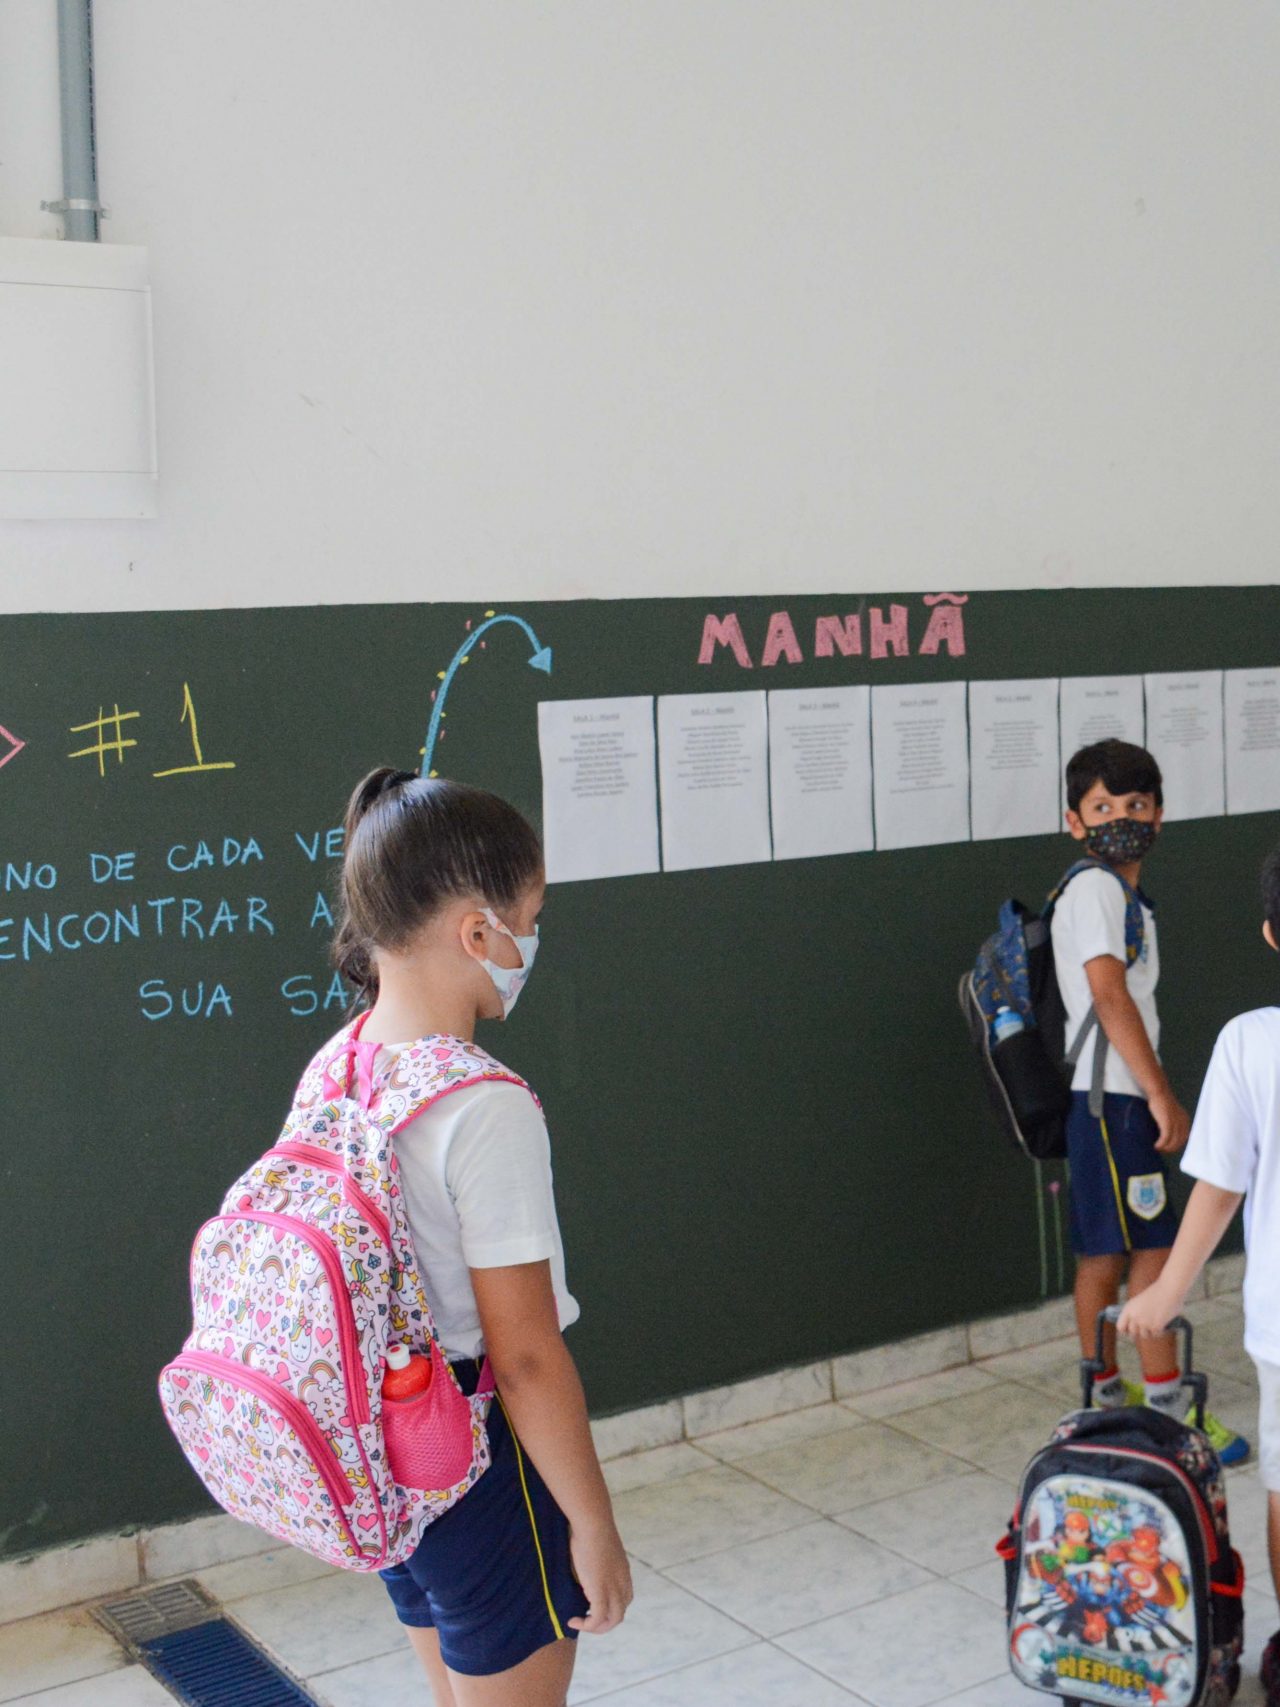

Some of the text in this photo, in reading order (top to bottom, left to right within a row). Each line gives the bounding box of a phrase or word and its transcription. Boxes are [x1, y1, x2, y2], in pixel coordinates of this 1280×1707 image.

[697, 592, 968, 669] MANHÃ
[0, 826, 346, 893] NO DE CADA VE
[0, 892, 335, 961] ENCONTRAR A
[138, 970, 366, 1021] SUA SA
